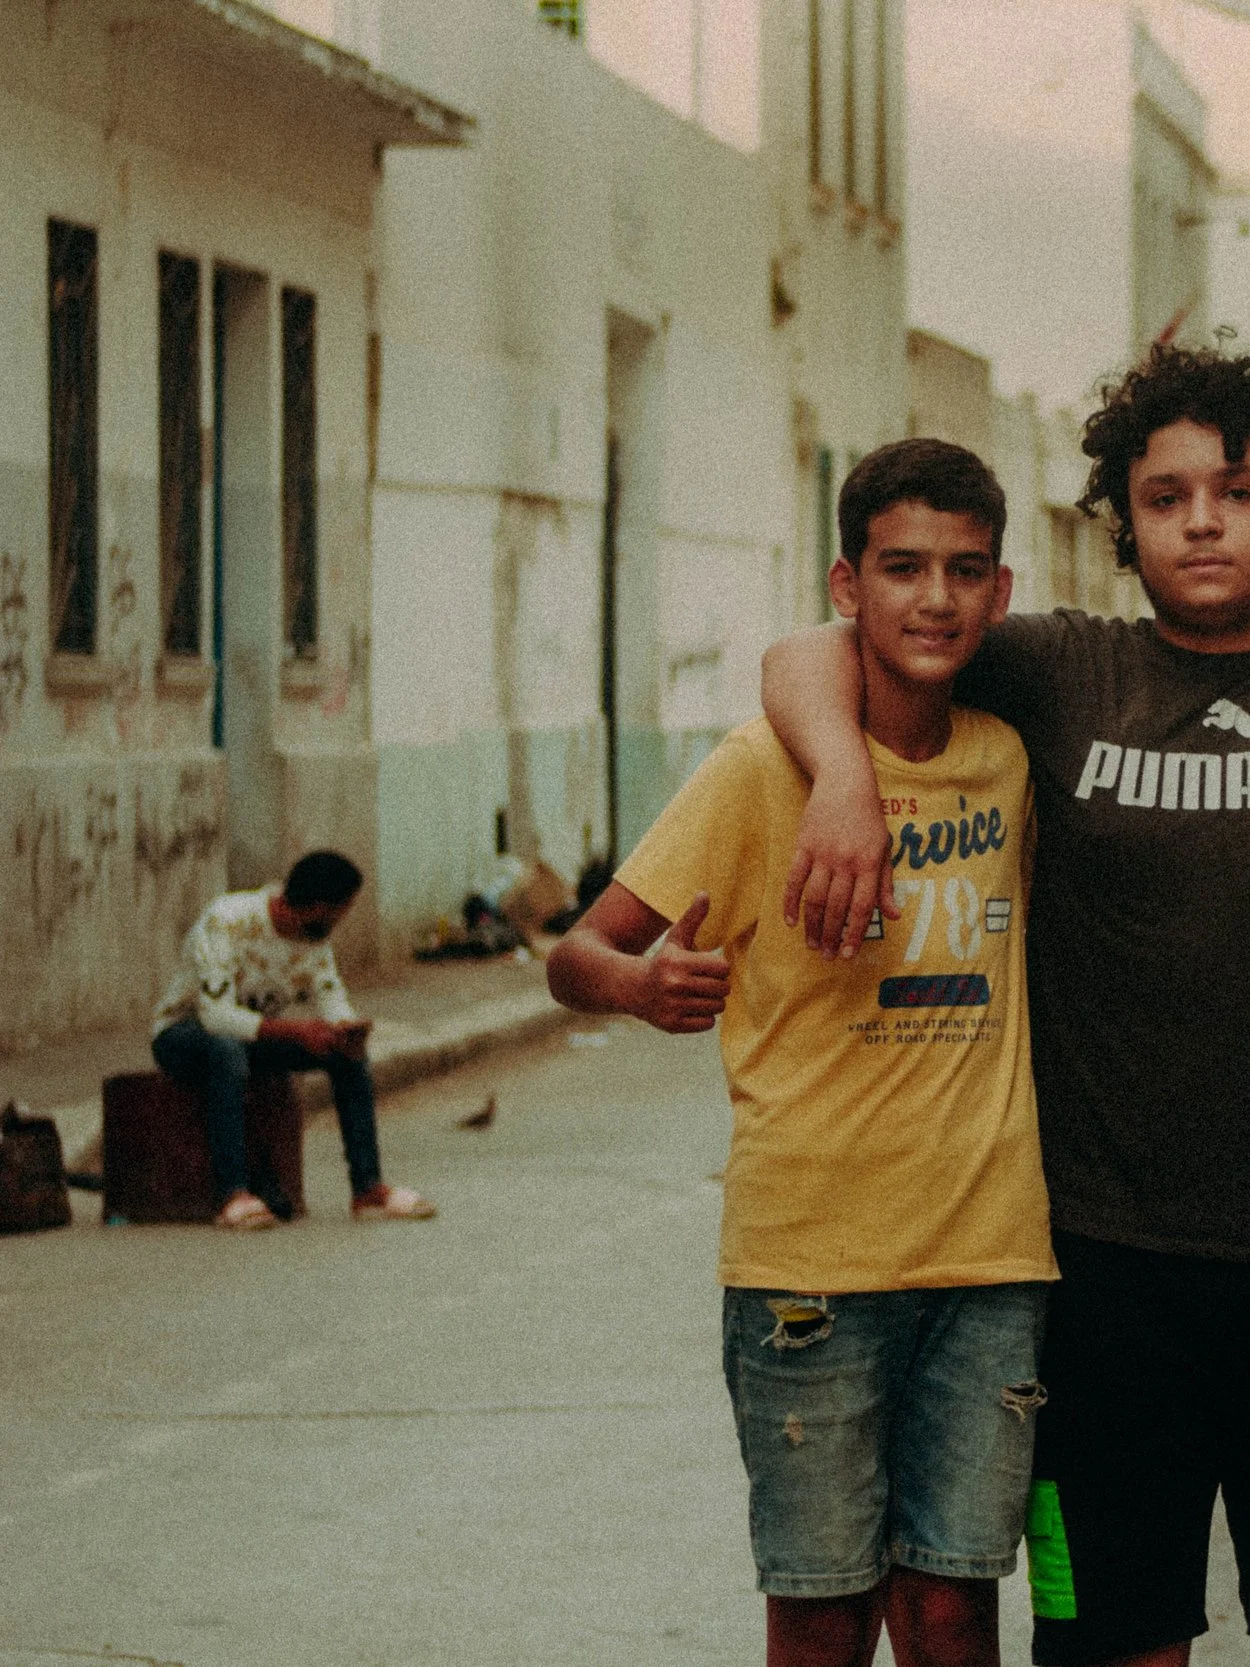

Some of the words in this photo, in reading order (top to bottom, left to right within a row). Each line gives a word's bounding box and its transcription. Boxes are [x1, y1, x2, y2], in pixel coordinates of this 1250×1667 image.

[892, 877, 982, 964] 78
[895, 1019, 920, 1030] AND
[865, 1034, 890, 1045] OFF
[896, 1033, 926, 1044] ROAD
